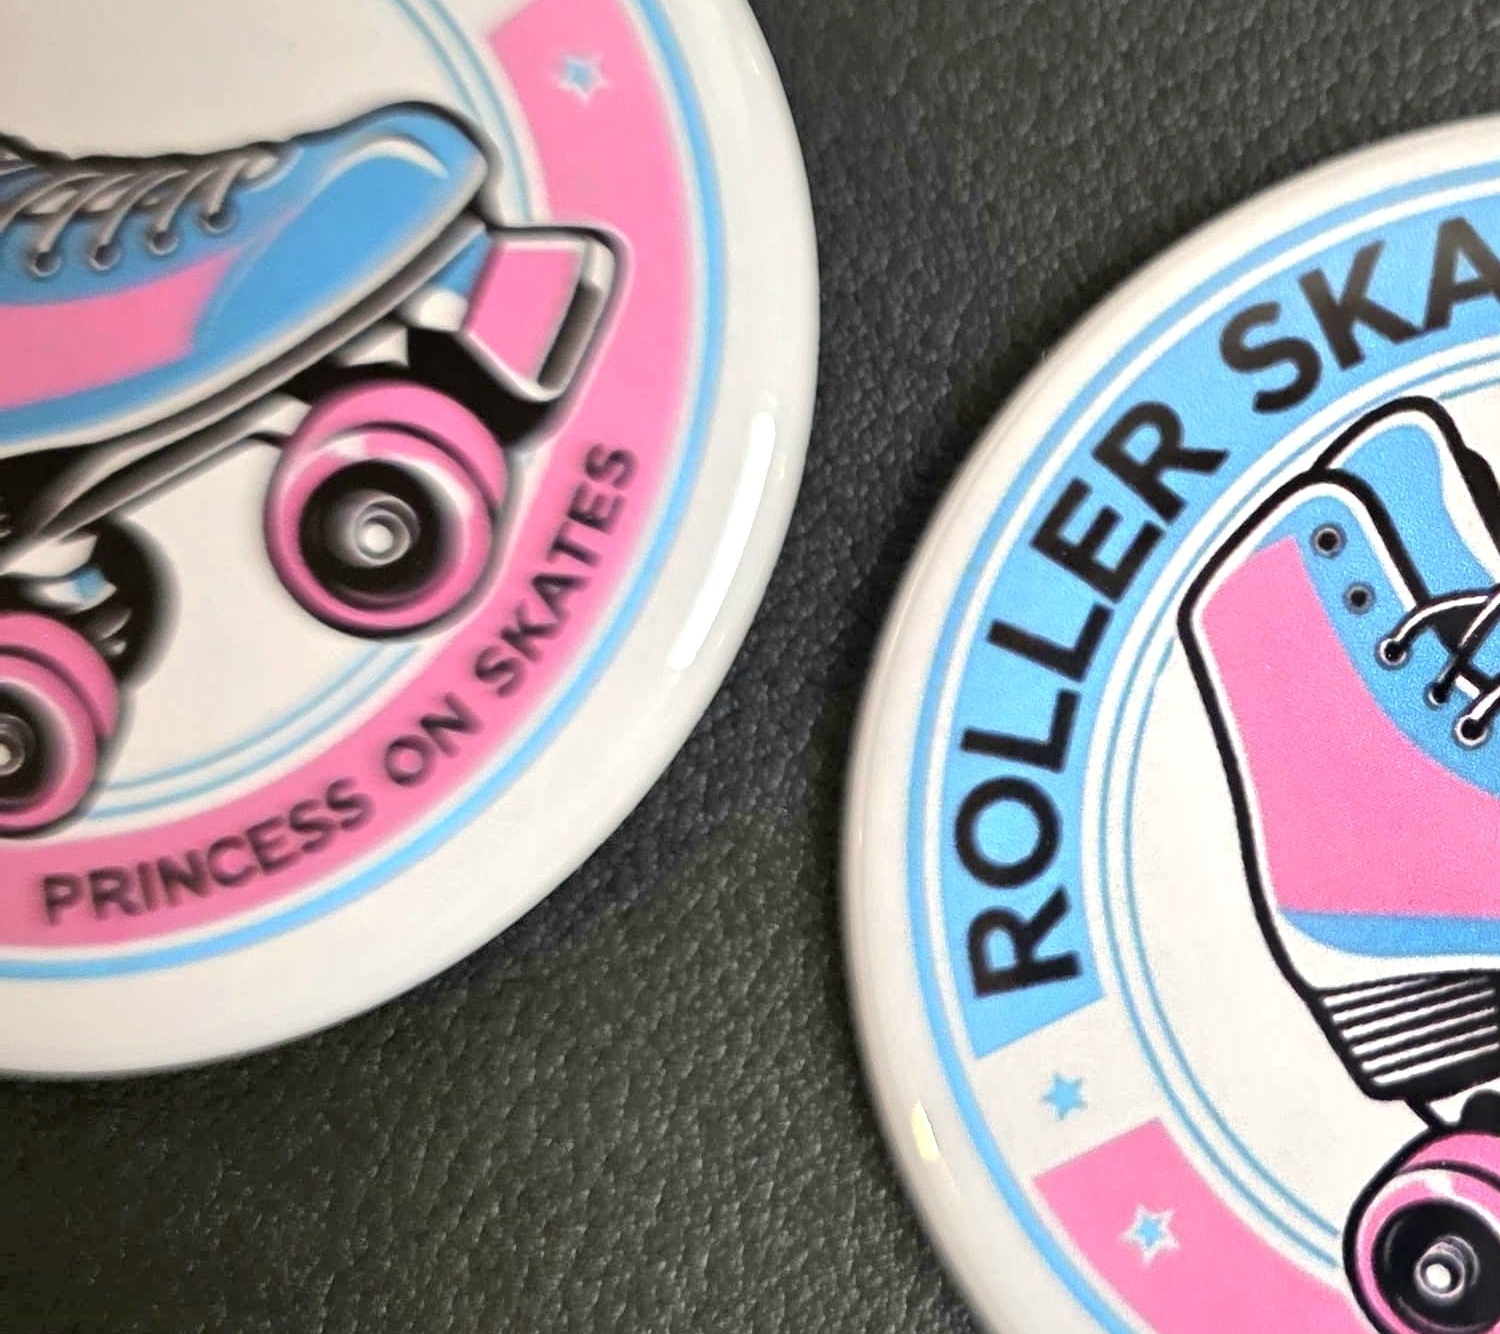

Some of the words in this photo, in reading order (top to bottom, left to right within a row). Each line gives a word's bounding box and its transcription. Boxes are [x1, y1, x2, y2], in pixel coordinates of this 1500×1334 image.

[41, 776, 372, 925] PRINCESS
[384, 695, 484, 787] ON
[475, 442, 636, 697] SKATES
[955, 401, 1229, 999] ROLLER
